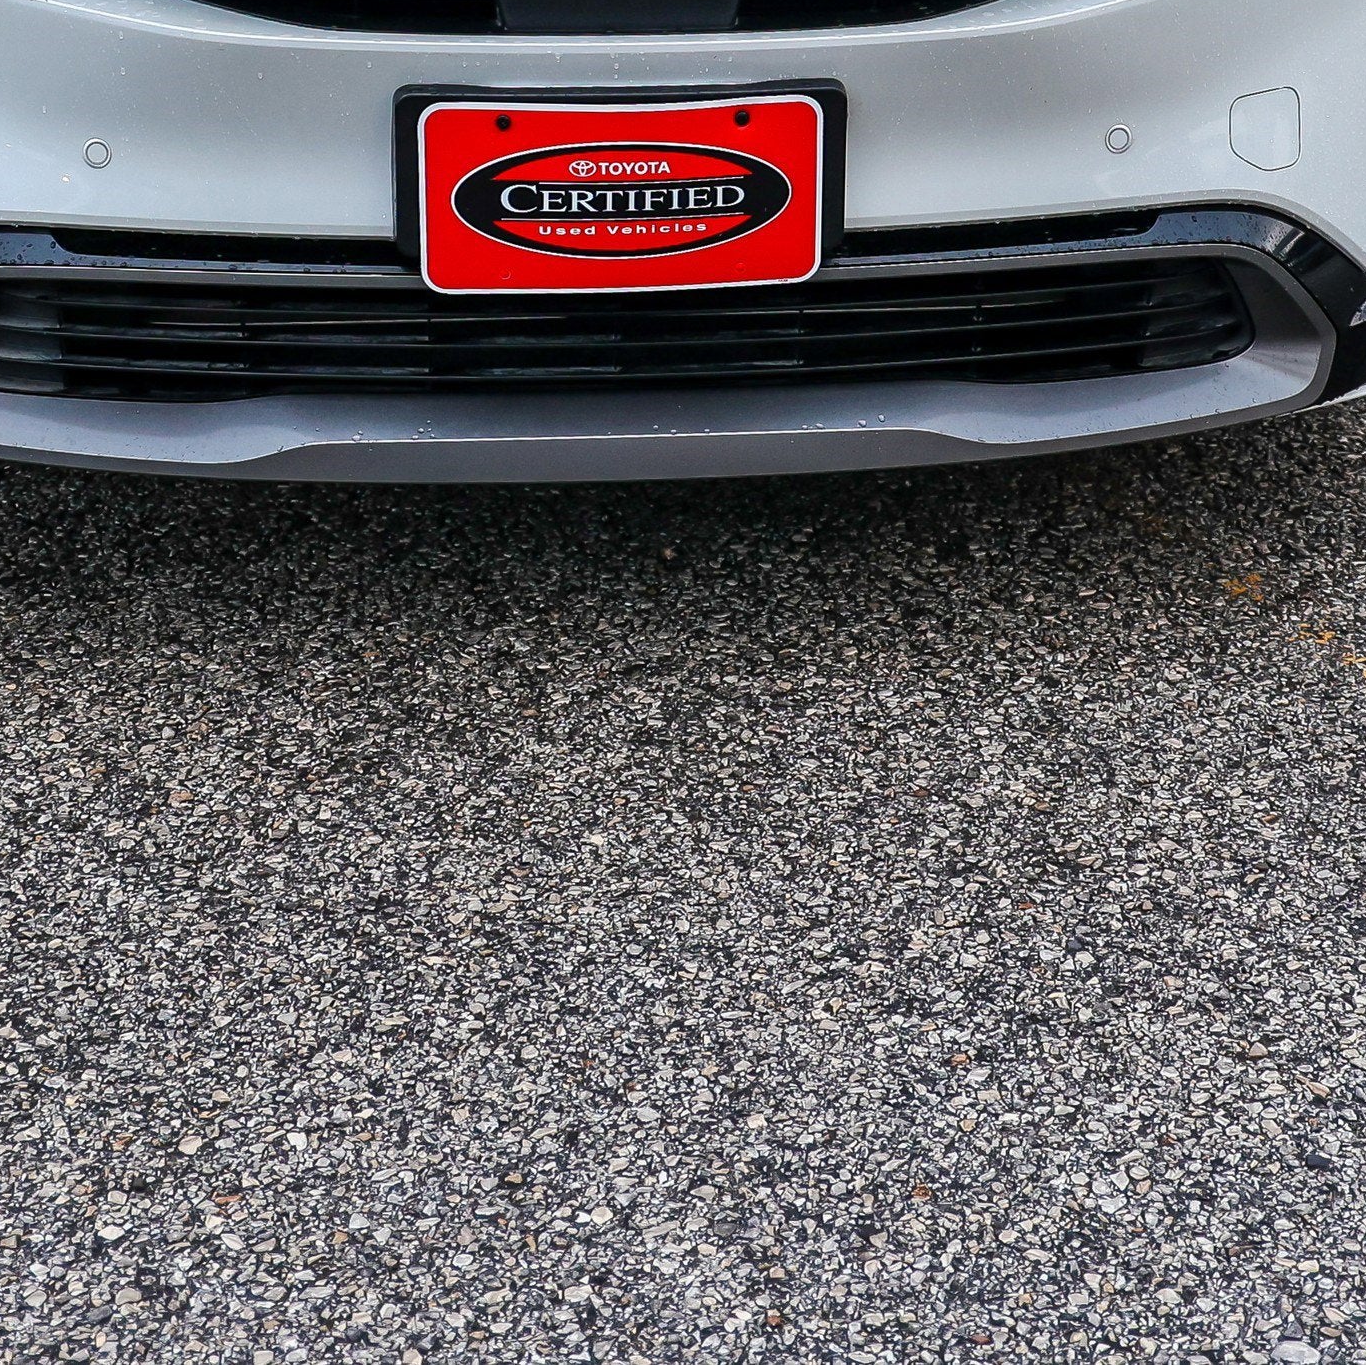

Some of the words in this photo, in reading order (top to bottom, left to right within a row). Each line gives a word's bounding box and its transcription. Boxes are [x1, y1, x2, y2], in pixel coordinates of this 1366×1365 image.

[598, 161, 671, 176] TOYOTA
[500, 184, 746, 214] CERTIFIED
[538, 224, 596, 236] Used
[607, 222, 707, 235] Vehicles
